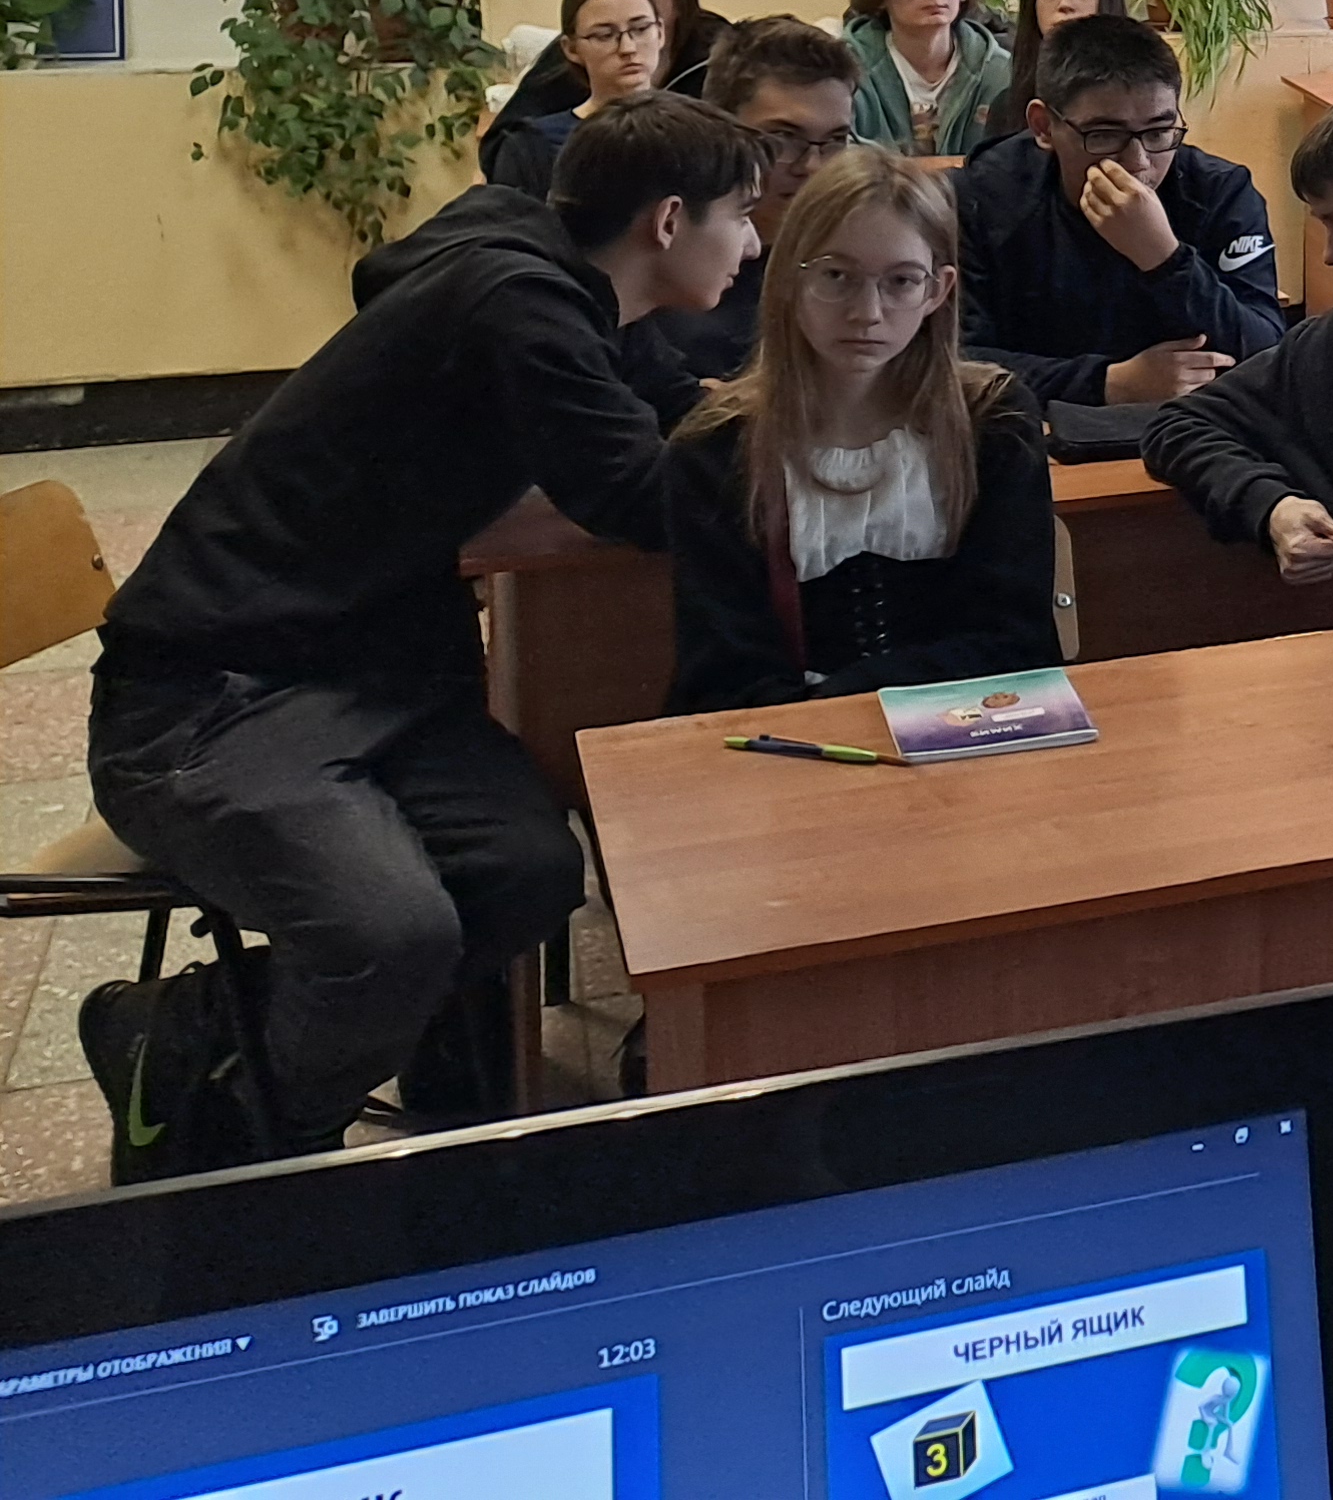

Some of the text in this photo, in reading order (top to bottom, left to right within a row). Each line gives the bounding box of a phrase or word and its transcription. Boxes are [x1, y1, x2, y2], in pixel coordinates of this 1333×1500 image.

[1227, 234, 1264, 254] NIKE
[356, 1267, 596, 1329] ЗАВЕРШИТЬ ПОКАЗ СЛАЙДОВ
[822, 1266, 1011, 1322] Следующий слайд
[598, 1337, 656, 1369] 12:03
[953, 1305, 1145, 1364] ЧЕРНЫЙ ЯЩИК
[96, 1338, 232, 1380] ОТОБРАЖЕНИЯ
[926, 1443, 948, 1477] 3
